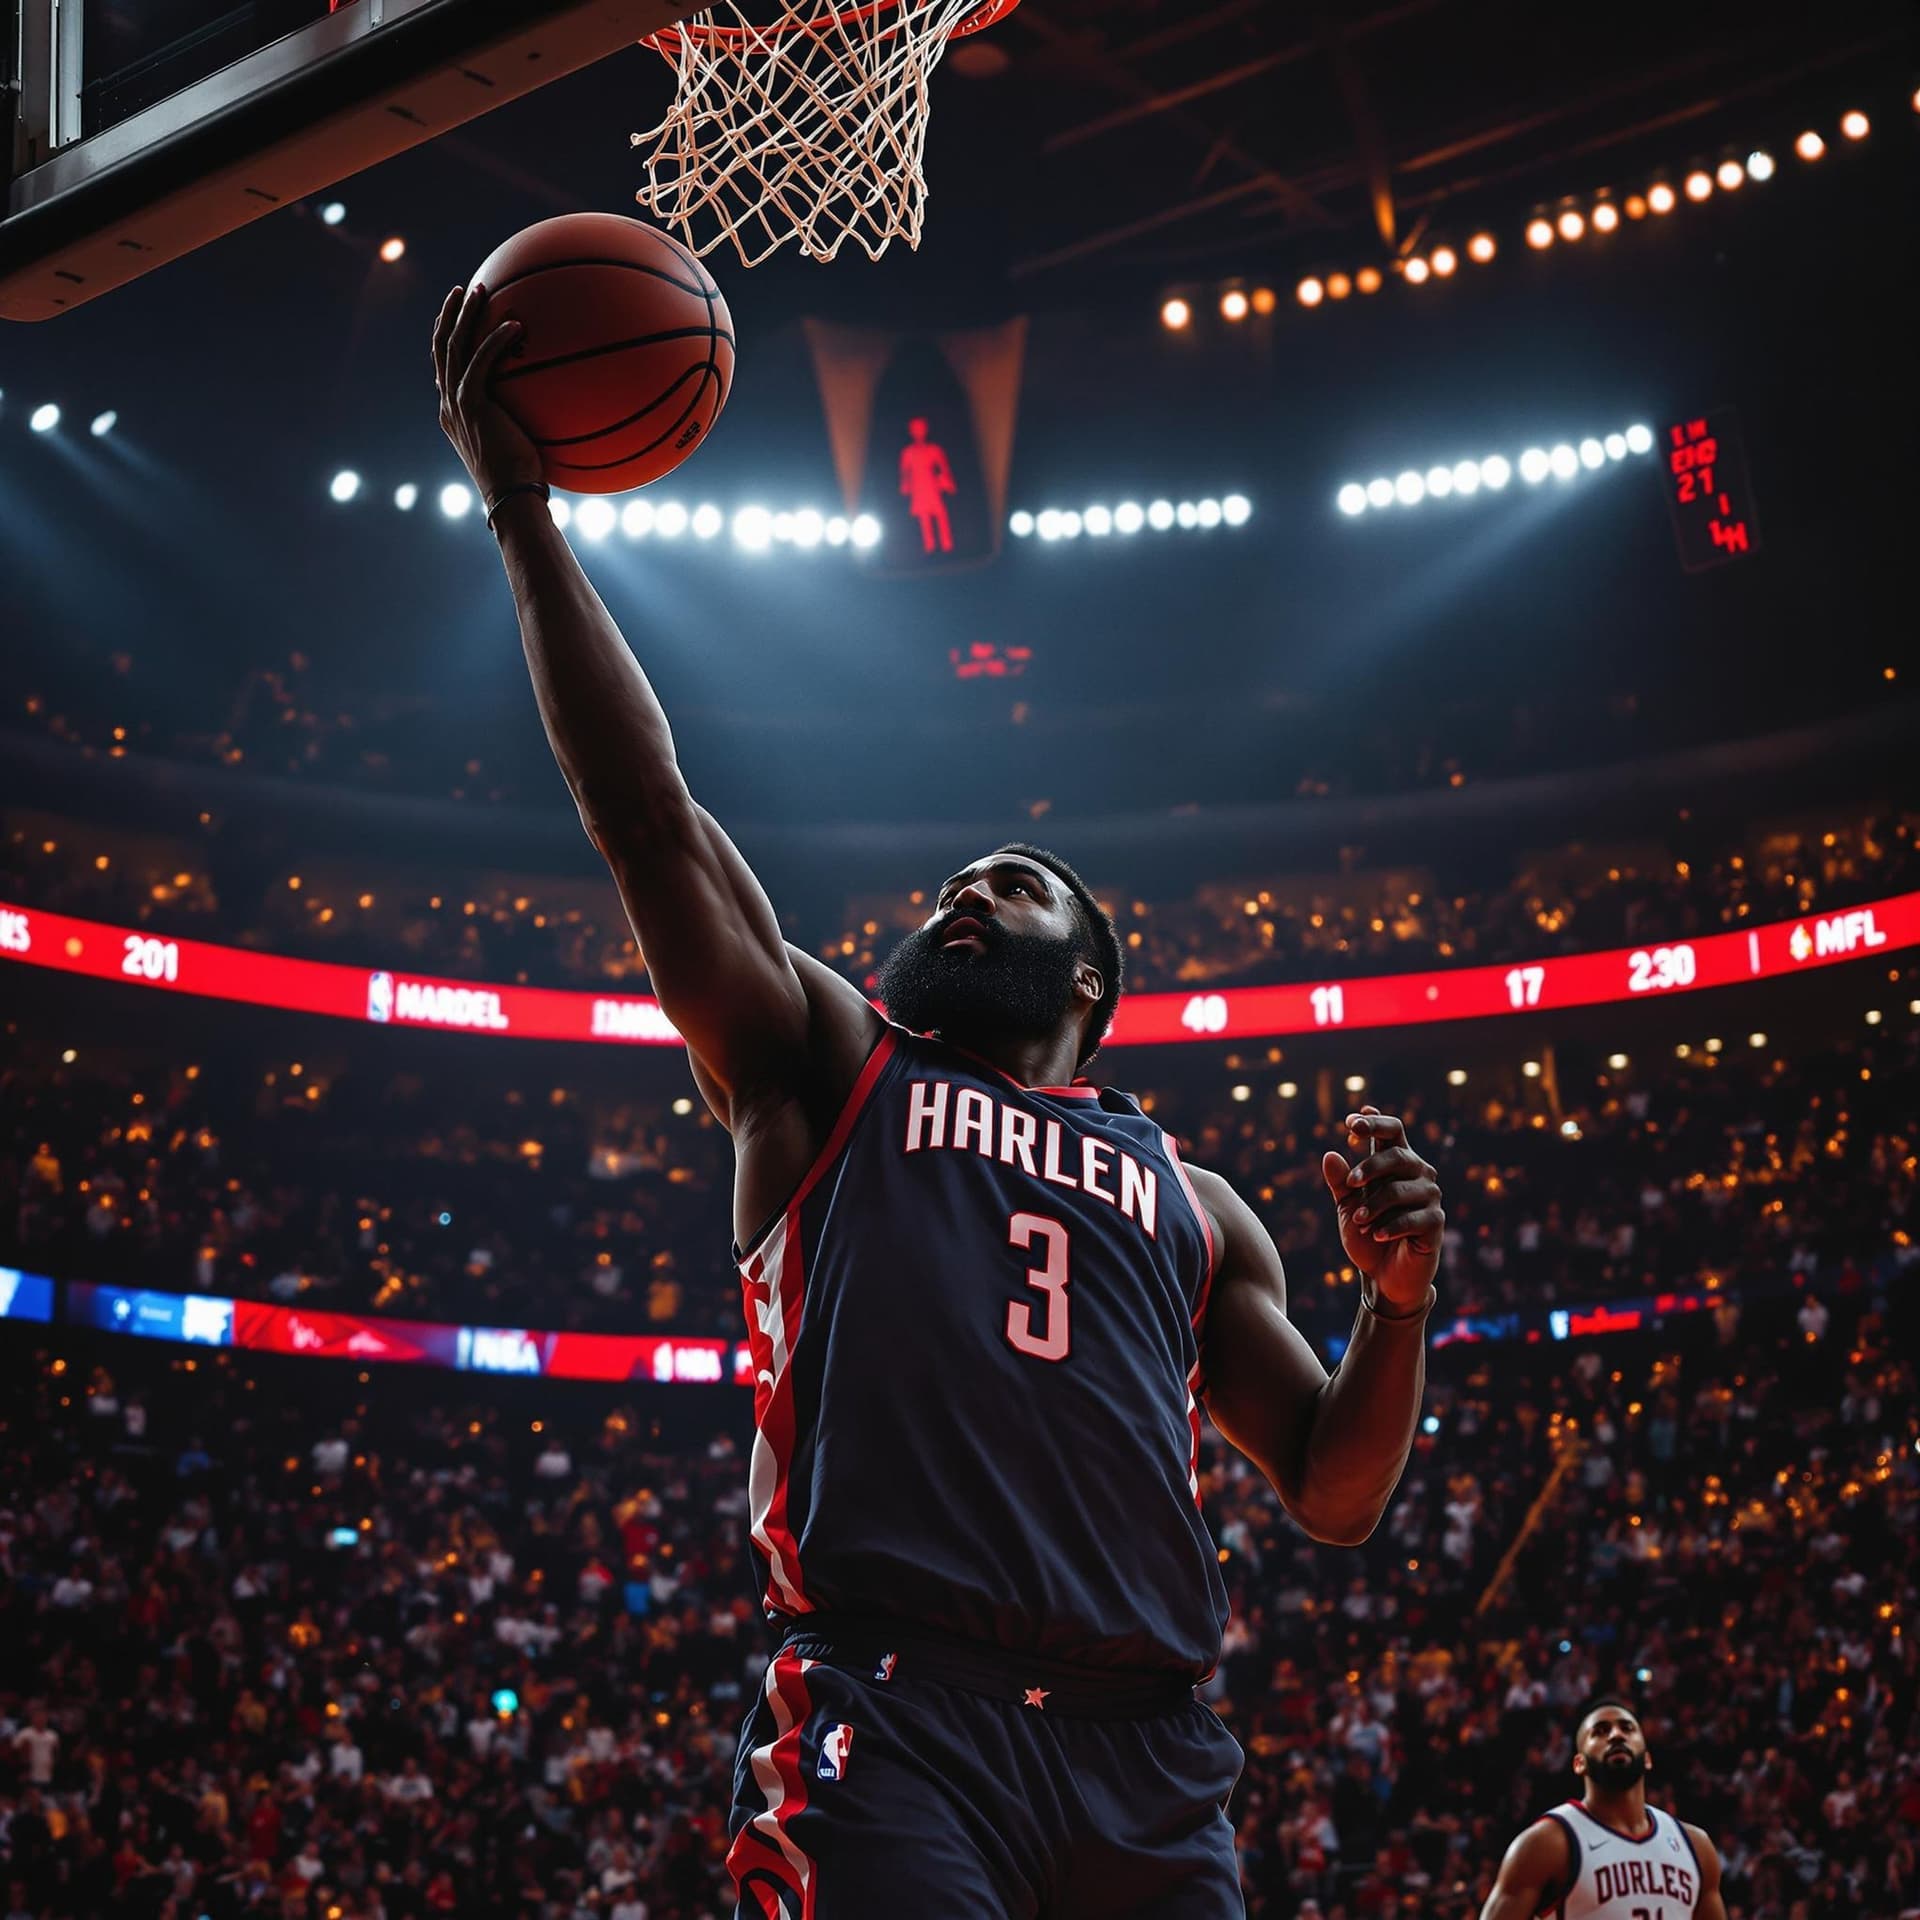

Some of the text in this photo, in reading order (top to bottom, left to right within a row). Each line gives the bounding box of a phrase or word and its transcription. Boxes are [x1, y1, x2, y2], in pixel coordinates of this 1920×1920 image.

[1815, 910, 1887, 957] MFL
[122, 935, 179, 982] 201
[1310, 985, 1344, 1025] 11
[1505, 966, 1546, 1008] 17
[1181, 995, 1228, 1033] 40
[904, 1080, 1158, 1242] HARLEN
[1007, 1209, 1071, 1363] 3
[1593, 1860, 1693, 1907] DURLES
